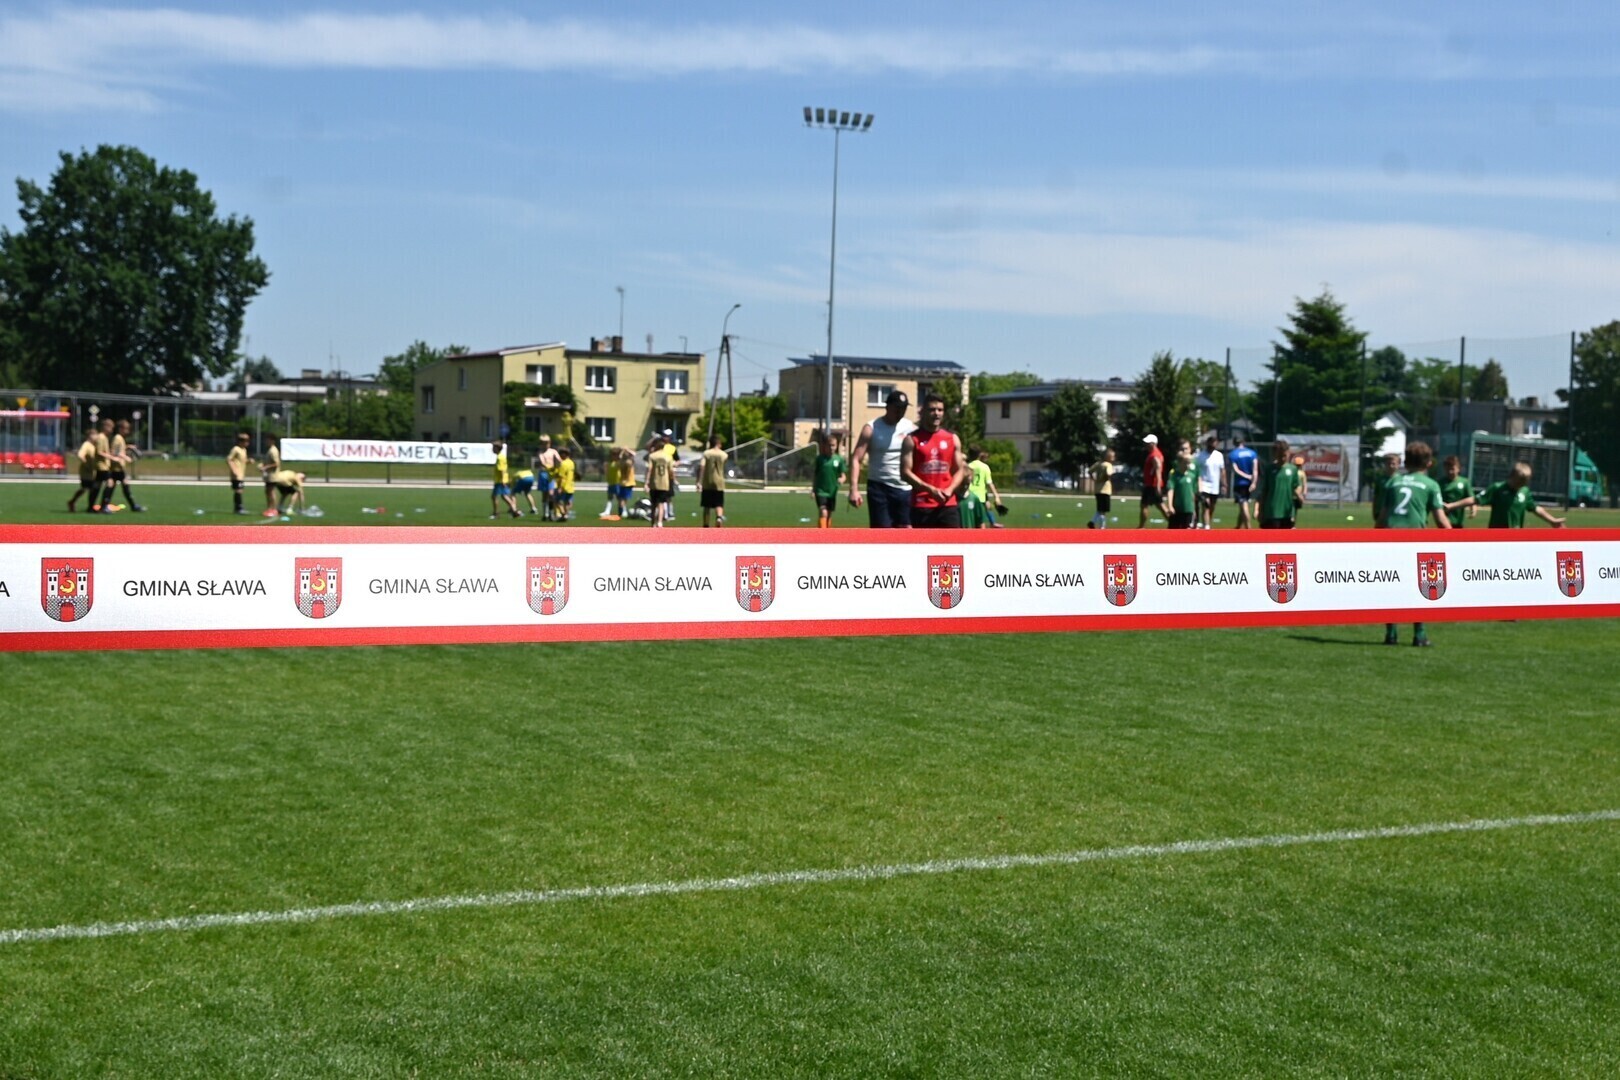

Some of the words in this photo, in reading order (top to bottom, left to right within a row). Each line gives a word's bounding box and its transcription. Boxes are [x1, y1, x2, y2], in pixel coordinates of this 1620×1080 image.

[321, 443, 469, 460] LUMINAMETALS
[1394, 487, 1412, 515] 2
[985, 575, 1032, 587] GMINA
[1036, 573, 1084, 587] SŁAWA
[1156, 573, 1200, 586] GMINA
[1204, 572, 1248, 585] SŁAWA
[1315, 571, 1355, 584] GMINA
[1359, 570, 1400, 583] SŁAWA
[1463, 570, 1499, 582] GMINA
[1503, 569, 1542, 581] SŁAWA
[1598, 567, 1620, 579] GMI
[124, 581, 191, 596] GMINA
[197, 580, 266, 596] SŁAWA
[370, 579, 430, 593] GMINA
[436, 578, 498, 593] SŁAWA
[594, 578, 650, 591] GMINA
[655, 576, 712, 591] SŁAWA
[798, 576, 849, 589] GMINA
[854, 575, 906, 589] SŁAWA
